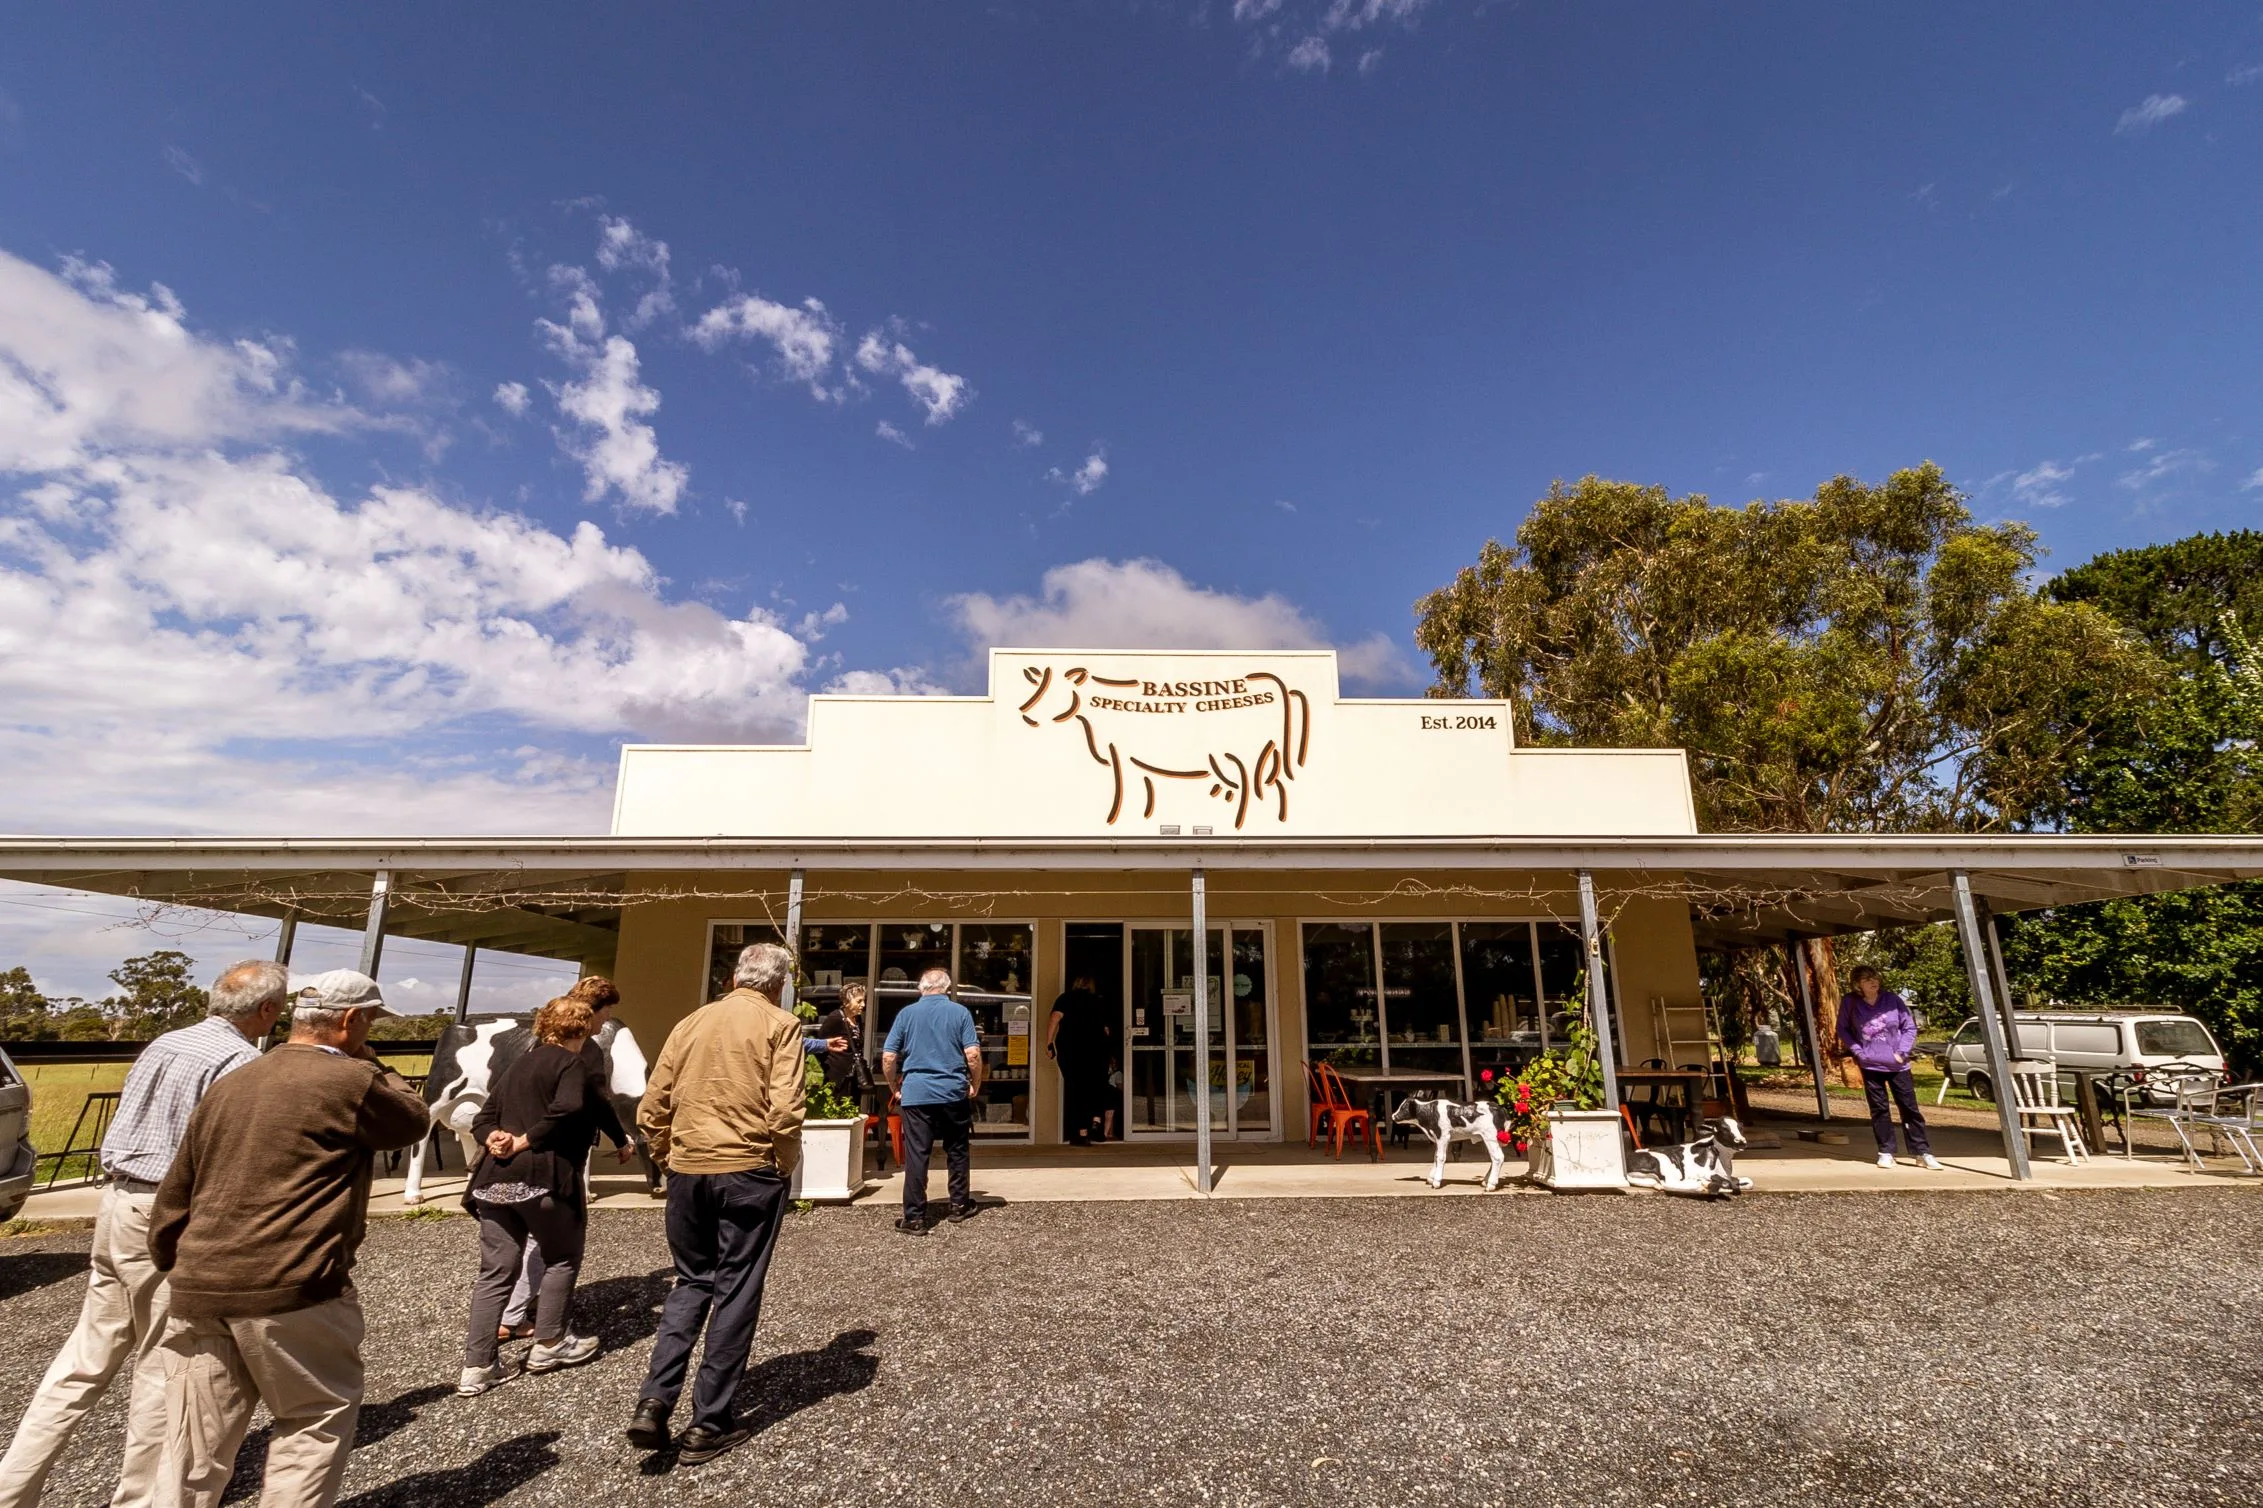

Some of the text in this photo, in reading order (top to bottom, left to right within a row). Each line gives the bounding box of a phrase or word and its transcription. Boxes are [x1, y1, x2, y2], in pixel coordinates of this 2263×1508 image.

[1141, 679, 1248, 697] BASSINE
[1089, 692, 1275, 714] SPECIALTY CHEESES
[1420, 716, 1498, 730] Est. 2014
